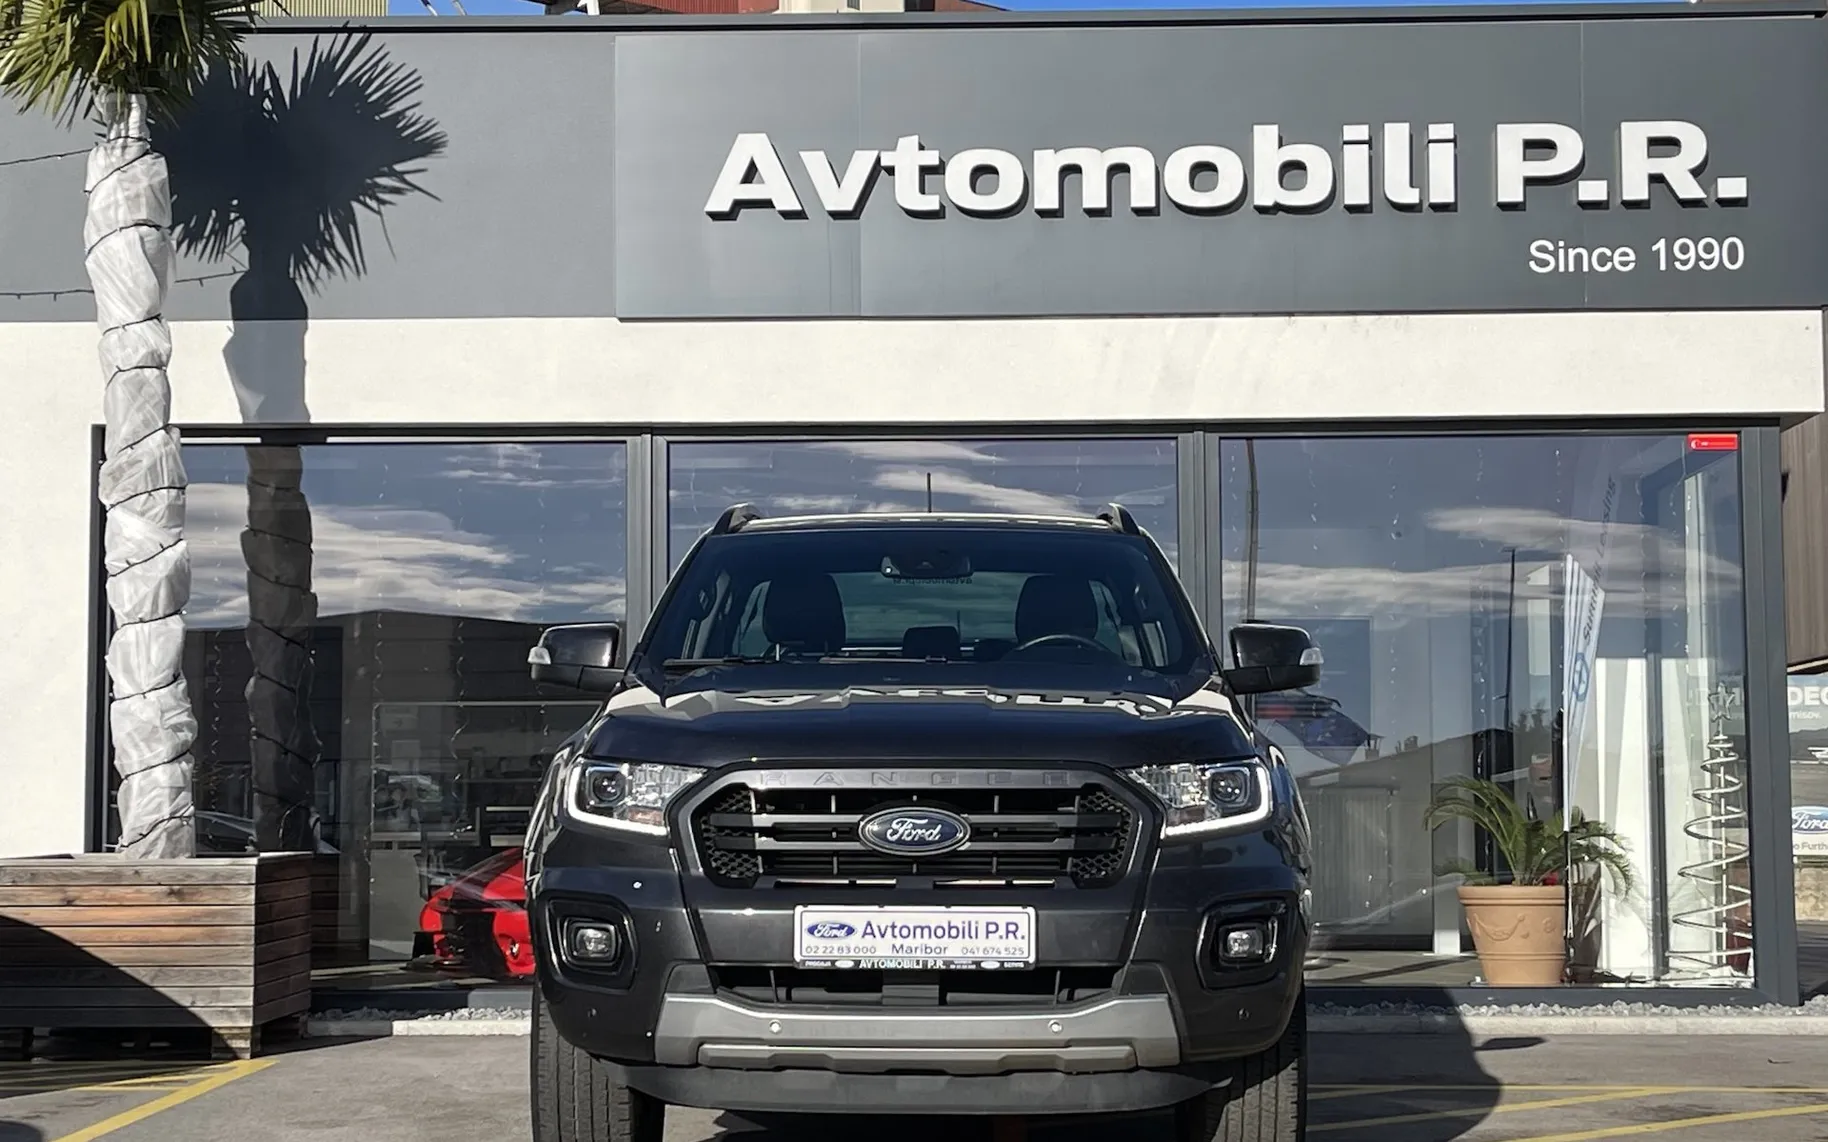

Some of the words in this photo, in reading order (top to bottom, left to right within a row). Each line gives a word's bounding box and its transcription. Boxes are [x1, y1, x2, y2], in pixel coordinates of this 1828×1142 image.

[704, 122, 1456, 219] Avtomobili
[1496, 120, 1748, 208] P.R.
[1529, 239, 1636, 273] Since
[1651, 237, 1745, 271] 1990
[760, 771, 1070, 786] RANGER
[861, 920, 979, 940] Avtomobili
[985, 922, 1026, 940] P.R.
[805, 945, 820, 955] 02
[822, 945, 835, 955] 22
[853, 945, 877, 955] 000
[891, 943, 949, 955] Maribor
[859, 958, 923, 969] AVTOMOBILI
